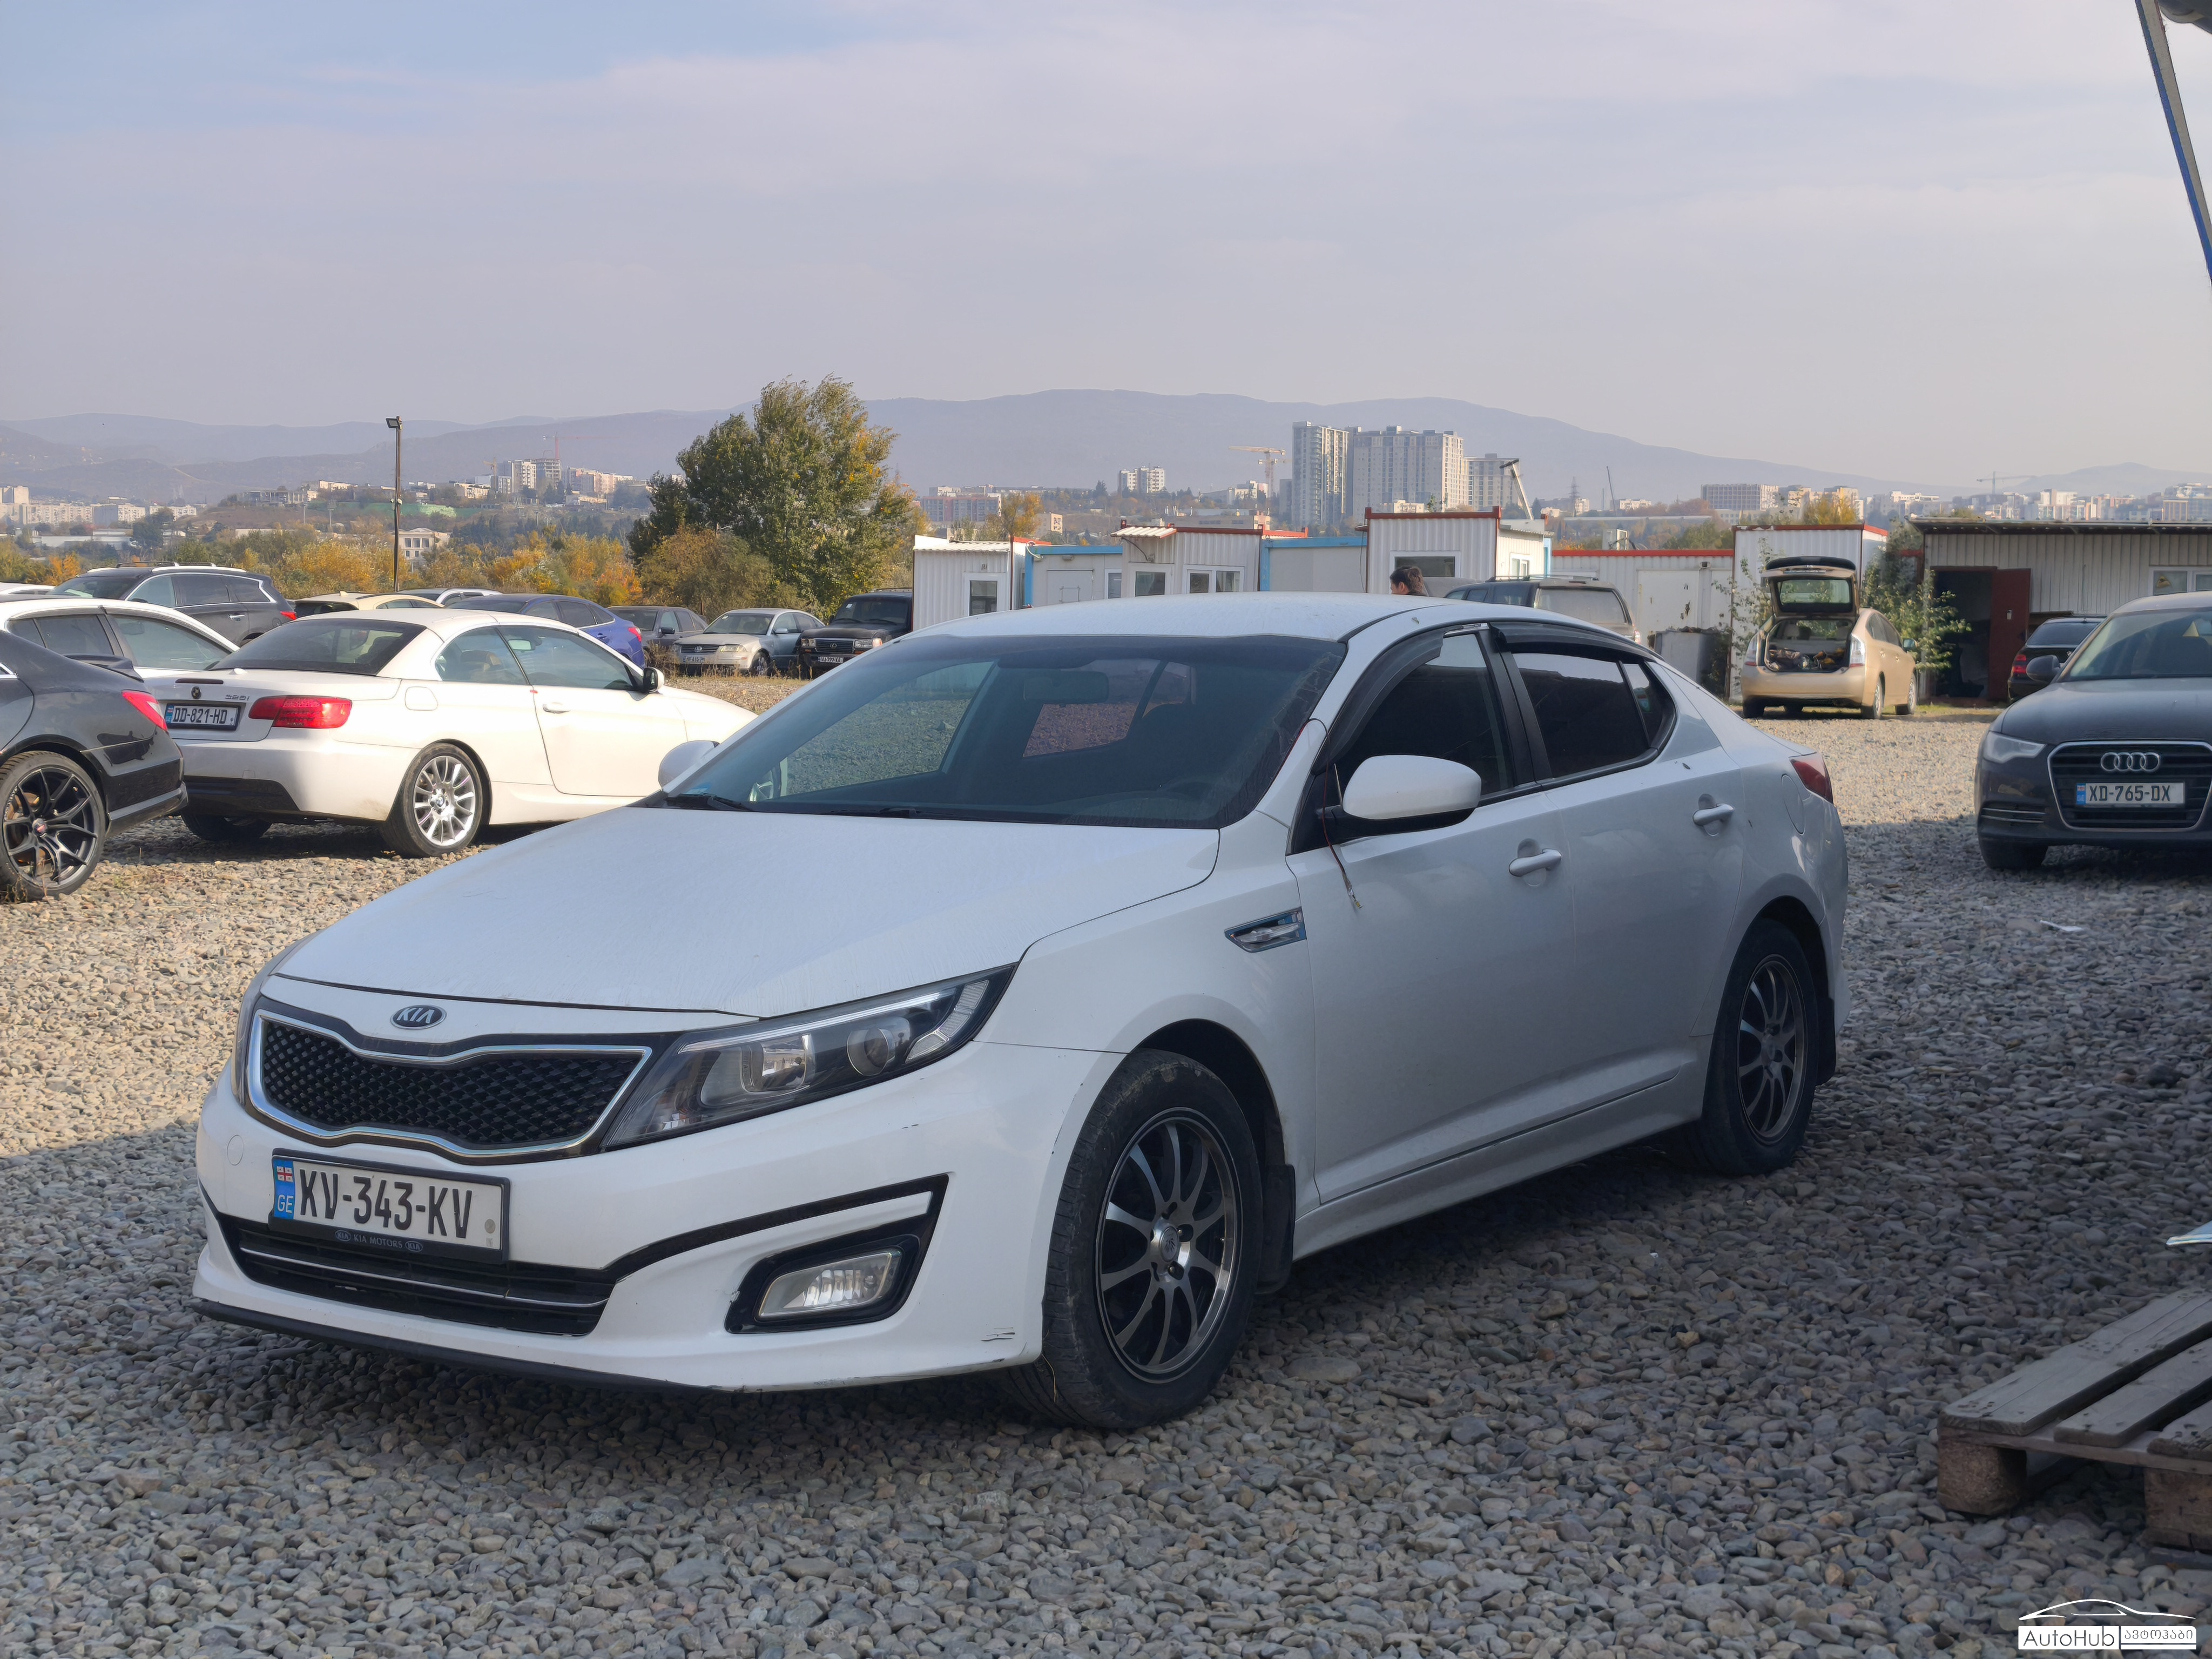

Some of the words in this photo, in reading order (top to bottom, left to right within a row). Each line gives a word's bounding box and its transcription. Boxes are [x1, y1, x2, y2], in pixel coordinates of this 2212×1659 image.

[173, 707, 227, 724] DD-821-HD
[2089, 785, 2170, 801] XD-765-DX
[396, 1007, 435, 1024] KIA
[277, 1194, 294, 1213] GE
[300, 1169, 472, 1238] KV-343-KV
[354, 1234, 367, 1243] KIA
[370, 1237, 403, 1249] MOTORS
